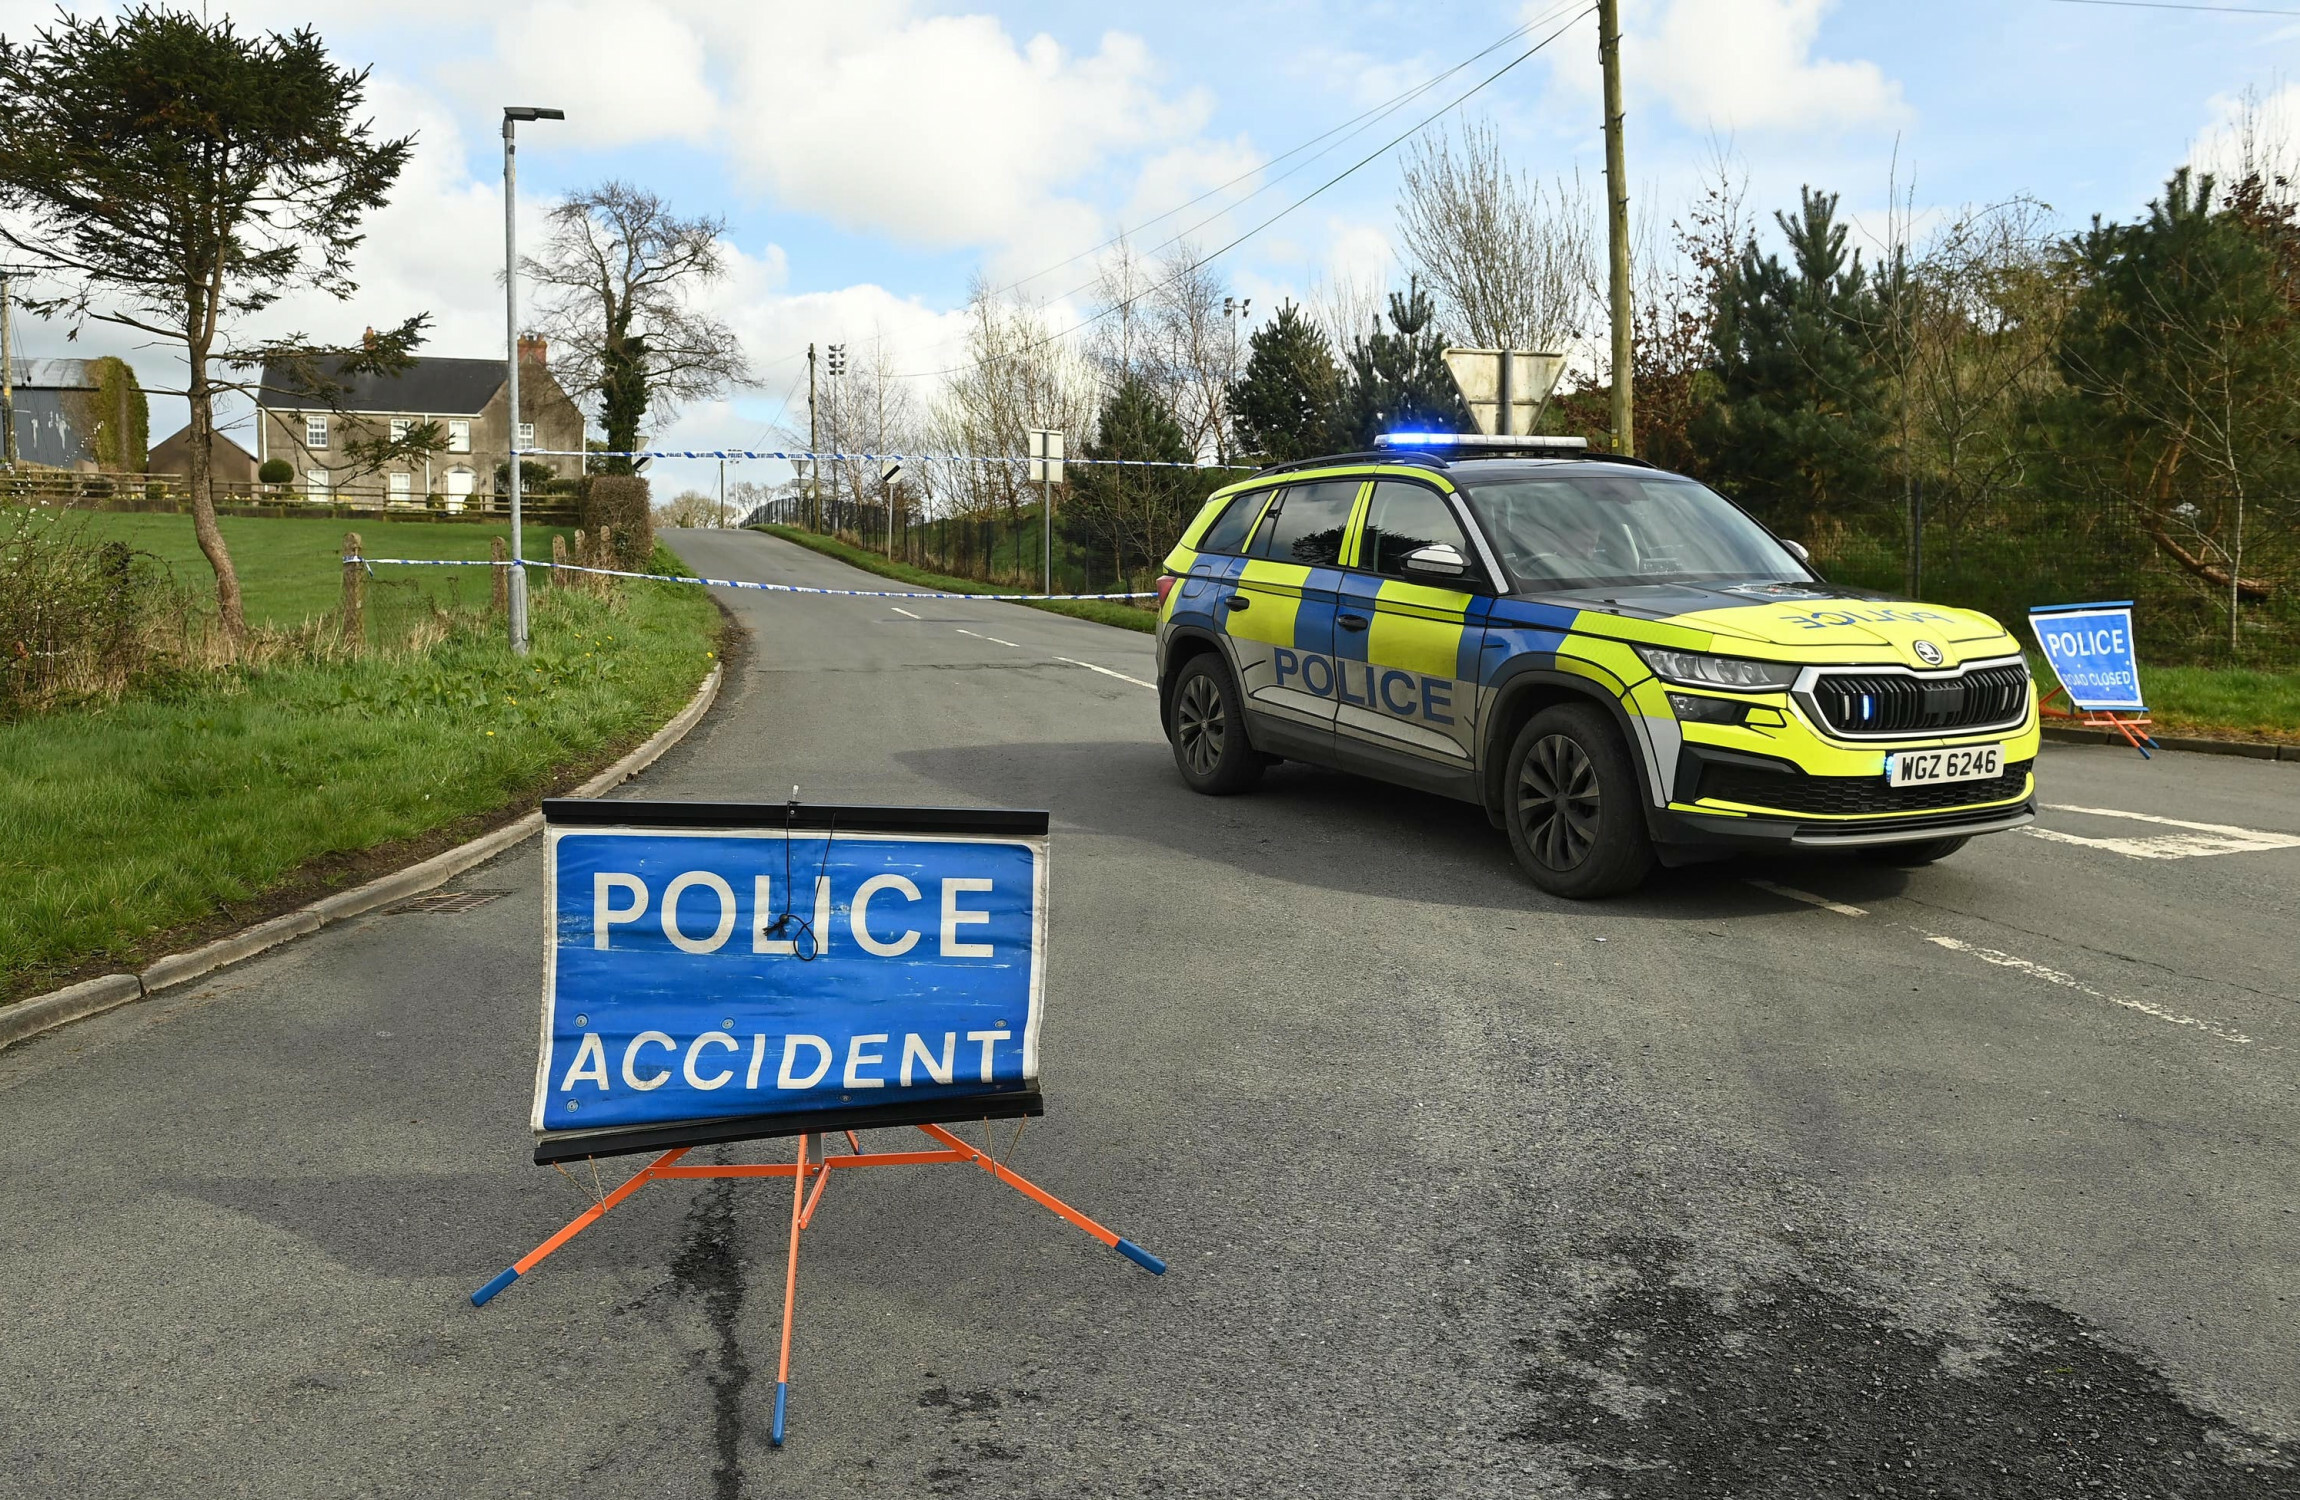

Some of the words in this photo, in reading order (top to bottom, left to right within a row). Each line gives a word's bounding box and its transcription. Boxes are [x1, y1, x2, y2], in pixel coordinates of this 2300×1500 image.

[2046, 629, 2126, 658] POLICE
[1273, 647, 1455, 726] POLICE
[2062, 673, 2089, 687] ROAD
[2090, 671, 2131, 687] CLOSED
[1901, 754, 1942, 781] WGZ
[1946, 749, 1997, 777] 6246
[594, 870, 994, 958] POLICE
[560, 1029, 1012, 1092] ACCIDENT
